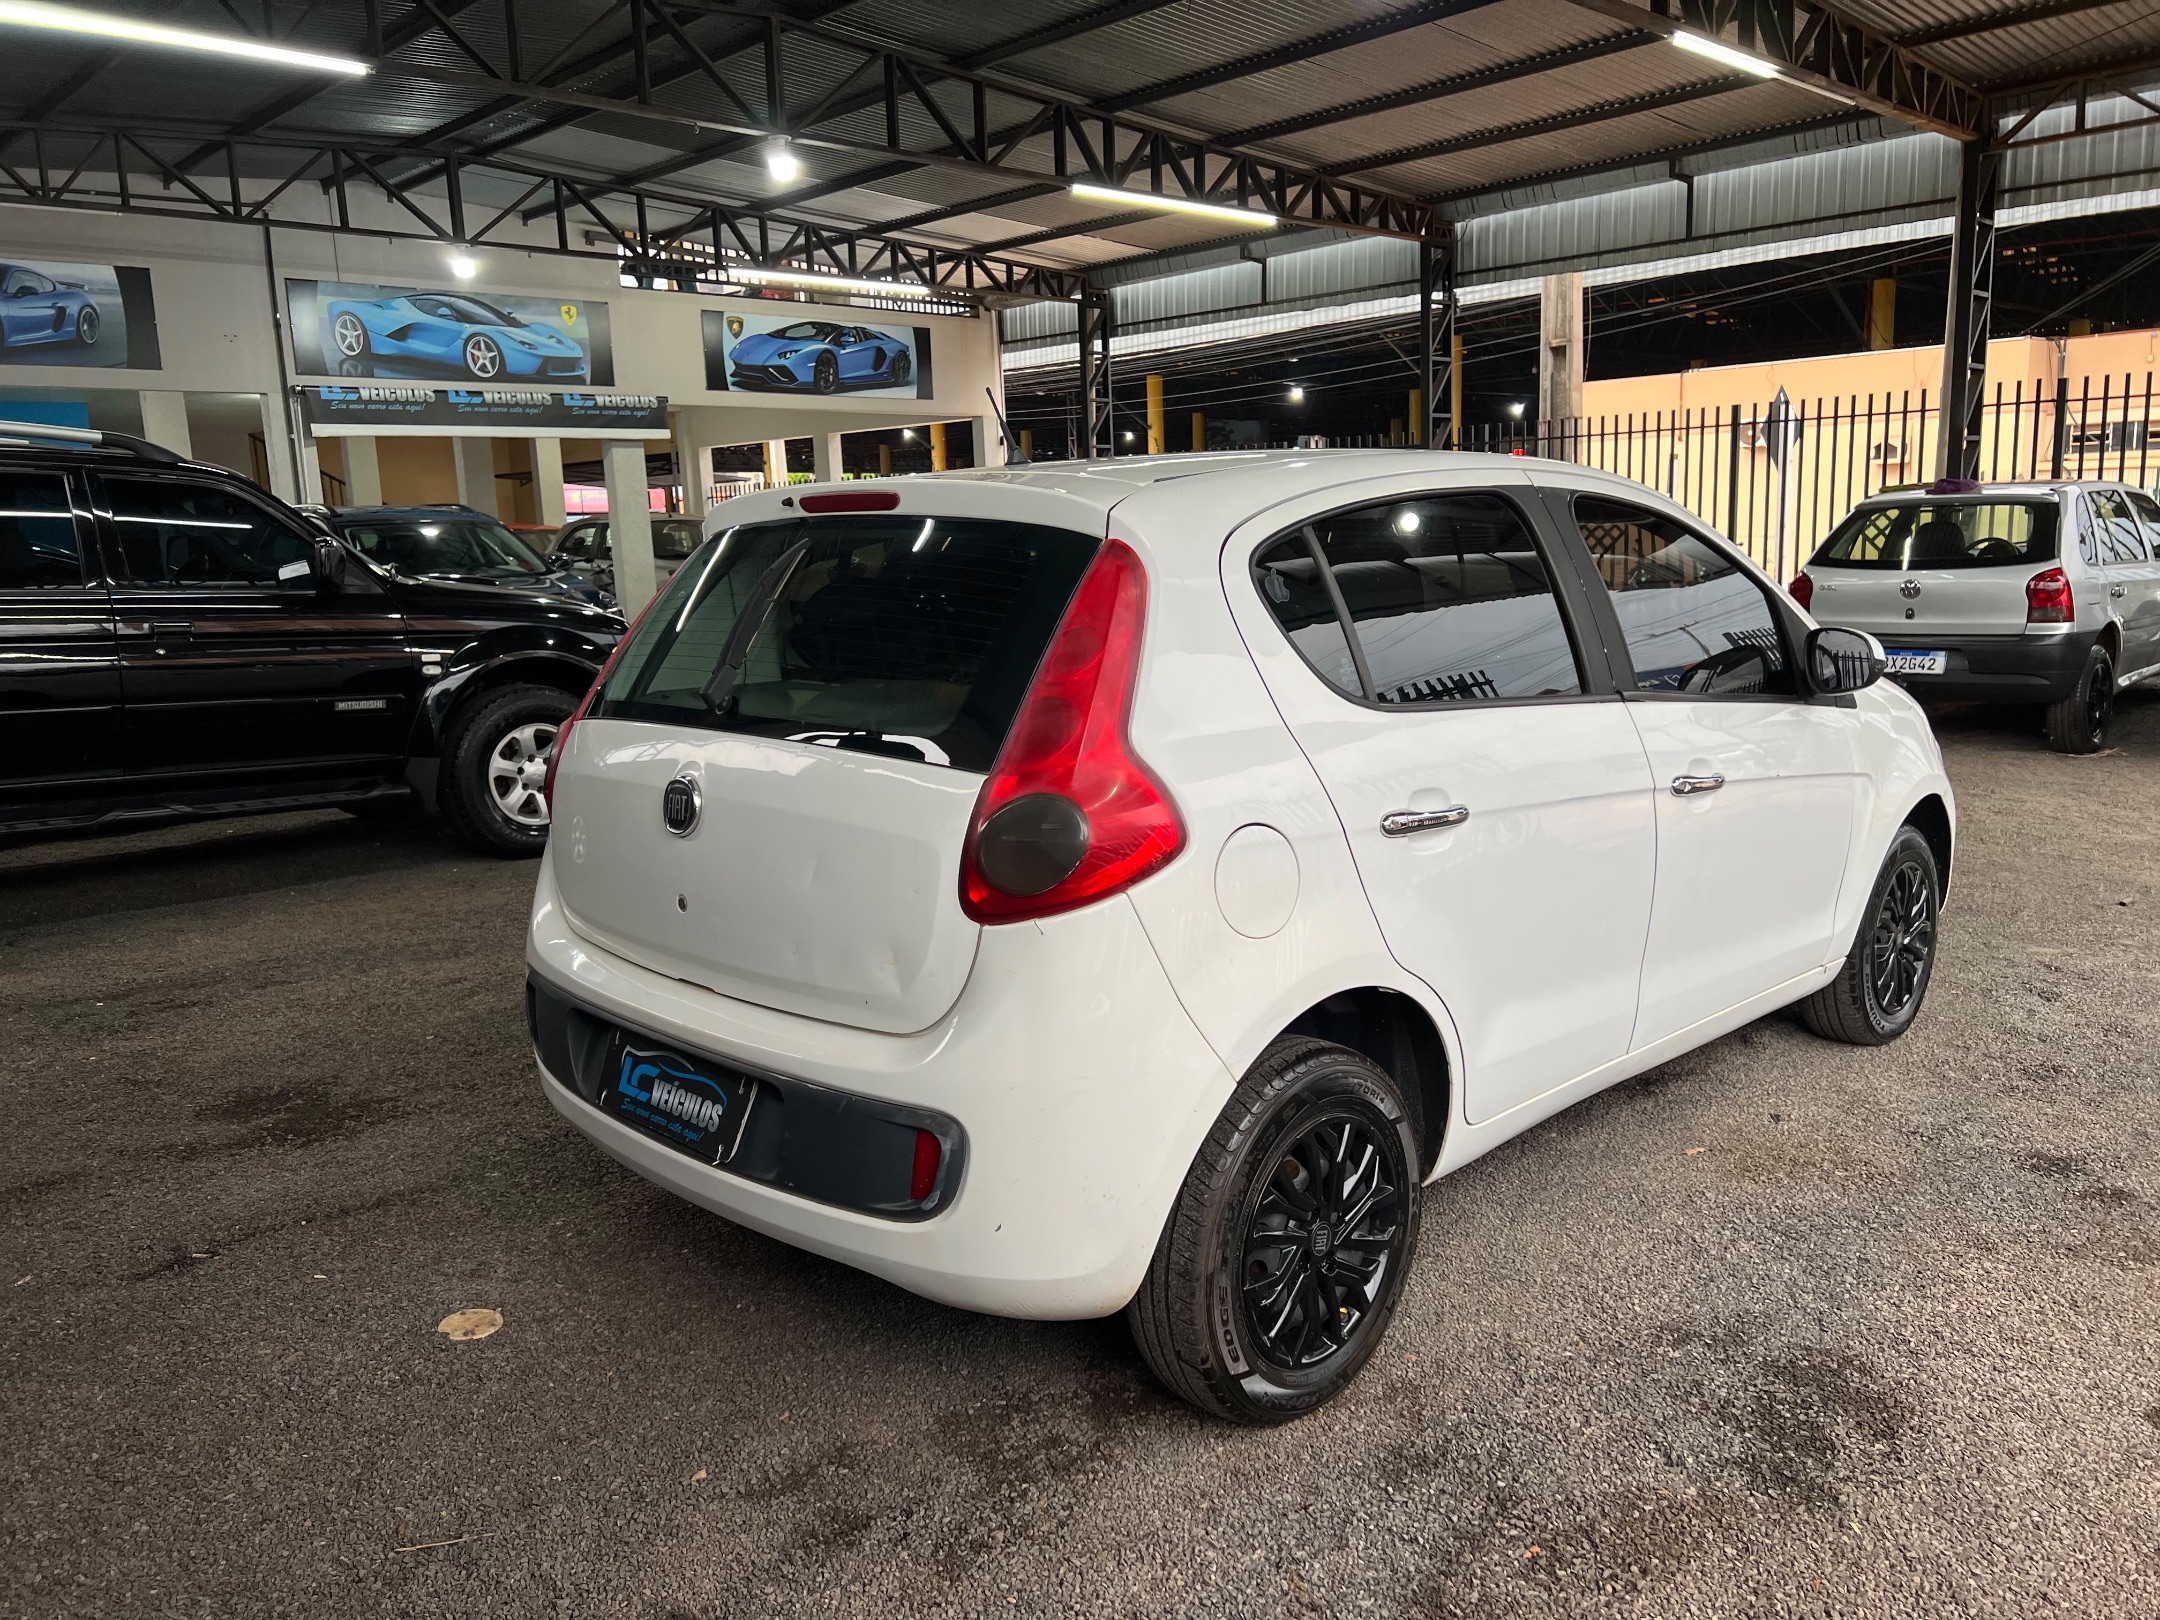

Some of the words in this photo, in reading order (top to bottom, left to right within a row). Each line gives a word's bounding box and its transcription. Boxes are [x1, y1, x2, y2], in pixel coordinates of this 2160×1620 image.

[331, 401, 346, 410] Seu
[405, 403, 427, 413] aqui!
[457, 404, 472, 413] Seu
[338, 700, 383, 710] MITSUBISHI
[668, 793, 688, 821] FIAT
[618, 1056, 661, 1102] LC
[620, 1097, 636, 1111] Seu
[1315, 1230, 1327, 1251] FIAT
[1219, 1286, 1240, 1363] EDGE
